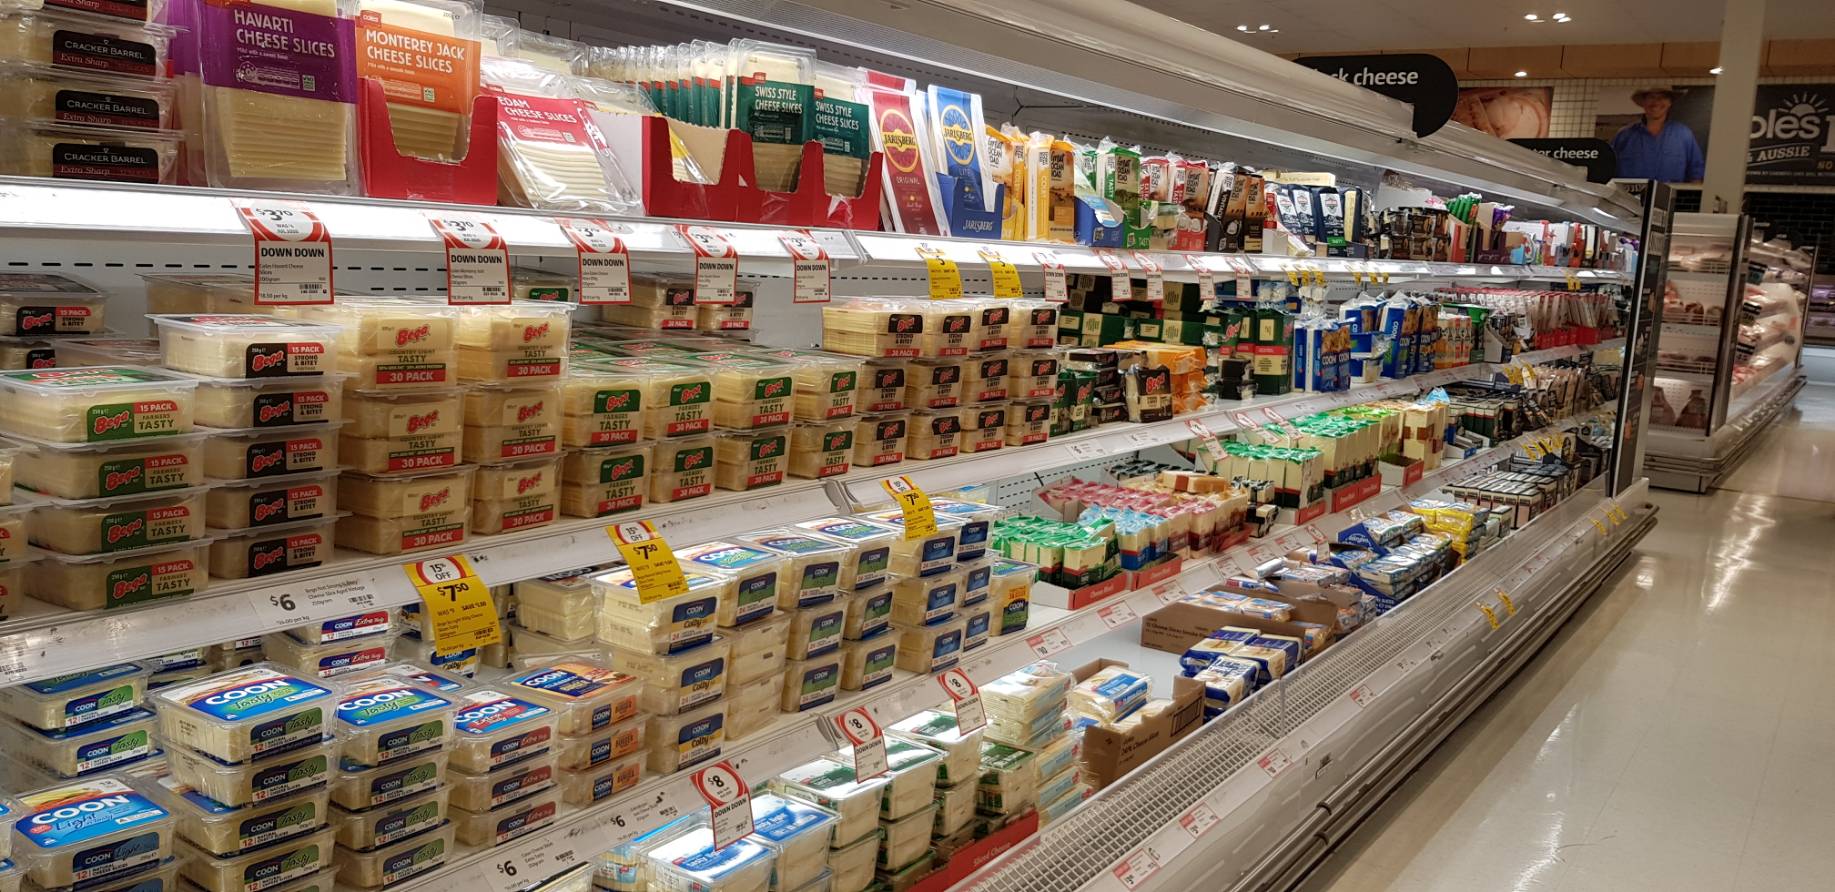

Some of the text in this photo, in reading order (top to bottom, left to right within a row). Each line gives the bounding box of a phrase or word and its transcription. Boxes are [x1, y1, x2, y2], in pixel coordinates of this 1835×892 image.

[234, 9, 294, 34] HAVARTI
[64, 39, 145, 60] CRACKER BARREL
[236, 28, 289, 51] CHEESE
[293, 38, 336, 59] SLICES
[366, 28, 465, 61] MONTEREY JACK
[61, 52, 110, 69] Extra Sharp
[367, 45, 412, 66] CHEESE
[415, 54, 453, 74] SLICES
[1353, 66, 1419, 86] cheese
[754, 85, 797, 101] SWISS STYLE
[66, 99, 148, 115] CRACKER BARREL
[499, 96, 528, 109] EDAM
[754, 99, 803, 115] CHEESE SLICES
[815, 100, 853, 117] SWISS STYLE
[63, 112, 112, 125] Extra Sharp
[505, 106, 542, 119] CHEESE
[544, 110, 577, 124] SLICES
[815, 113, 860, 130] CHEESE SLICES
[1749, 108, 1821, 139] oles
[883, 132, 918, 152] JARLSBERG
[943, 126, 974, 146] JARLSBERG
[64, 152, 146, 165] CRACKER BARREL
[1553, 147, 1599, 159] cheese
[1756, 145, 1811, 162] AUSSIE
[896, 176, 921, 186] ORIGINAL
[962, 219, 993, 232] JARLSBERG
[261, 247, 325, 258] DOWN DOWN
[451, 254, 502, 264] DOWN DOWN
[582, 258, 625, 267] DOWN DOWN
[699, 262, 734, 271] DOWN DOWN
[796, 264, 827, 272] DOWN DOWN
[22, 313, 53, 330] Bega
[397, 323, 431, 348] Bega
[523, 322, 550, 343] Bega
[300, 345, 320, 353] PACK
[524, 350, 546, 358] TASTY
[899, 349, 915, 357] PACK
[252, 350, 284, 372] Bega
[397, 354, 428, 363] TASTY
[1321, 354, 1337, 366] COON
[390, 372, 434, 383] 30 PACK
[517, 366, 551, 376] 30 PACK
[306, 394, 325, 402] PACK
[140, 402, 173, 412] 15 PACK
[259, 401, 290, 422] Bega
[759, 403, 784, 414] TASTY
[94, 410, 130, 434] Bega
[407, 409, 439, 434] Bega
[674, 410, 703, 422] TASTY
[767, 414, 784, 422] PACK
[138, 419, 175, 430] TASTY
[600, 419, 631, 431] TASTY
[684, 421, 703, 431] PACK
[610, 431, 629, 440] PACK
[408, 440, 437, 450] TASTY
[511, 444, 546, 455] 30 PACK
[151, 457, 183, 467] 15 PACK
[401, 456, 444, 469] 30 PACK
[106, 466, 141, 491] Bega
[149, 472, 185, 485] TASTY
[299, 489, 318, 497] PACK
[605, 485, 636, 500] TASTY
[255, 498, 284, 521] Bega
[617, 499, 636, 508] PACK
[421, 516, 448, 527] TASTY
[414, 532, 453, 546] 30 PACK
[630, 533, 644, 542] OFF
[158, 563, 189, 574] 15 PACK
[435, 571, 452, 581] OFF
[113, 573, 148, 599] Bega
[156, 578, 191, 592] TASTY
[269, 593, 296, 611] $6
[1008, 601, 1024, 611] COON
[437, 609, 450, 617] WAS
[686, 604, 704, 615] COON
[334, 616, 375, 629] COON Extra
[683, 619, 702, 629] Colby
[672, 632, 680, 641] 24
[526, 669, 568, 686] COON
[205, 678, 292, 706] COON
[692, 681, 710, 693] Colby
[74, 693, 125, 713] COON Tasty
[234, 693, 272, 711] Tasty
[338, 689, 416, 711] COON
[363, 702, 398, 717] Tasty
[453, 699, 517, 724] COON
[592, 709, 611, 722] COON
[67, 716, 78, 726] 12
[260, 714, 314, 738] COON Tasty
[849, 718, 863, 729] $8
[387, 727, 436, 747] COON Tasty
[502, 742, 520, 751] COON
[263, 761, 318, 786] COON Tasty
[707, 775, 725, 788] $8
[254, 791, 266, 800] 12
[31, 794, 131, 825] COON
[714, 798, 747, 818] DOWN DOWN
[56, 812, 96, 832] Light
[250, 820, 274, 833] COON
[609, 815, 626, 828] $6
[242, 837, 254, 847] 12
[85, 852, 112, 865] COON
[496, 860, 518, 877] $6
[75, 871, 89, 881] 12
